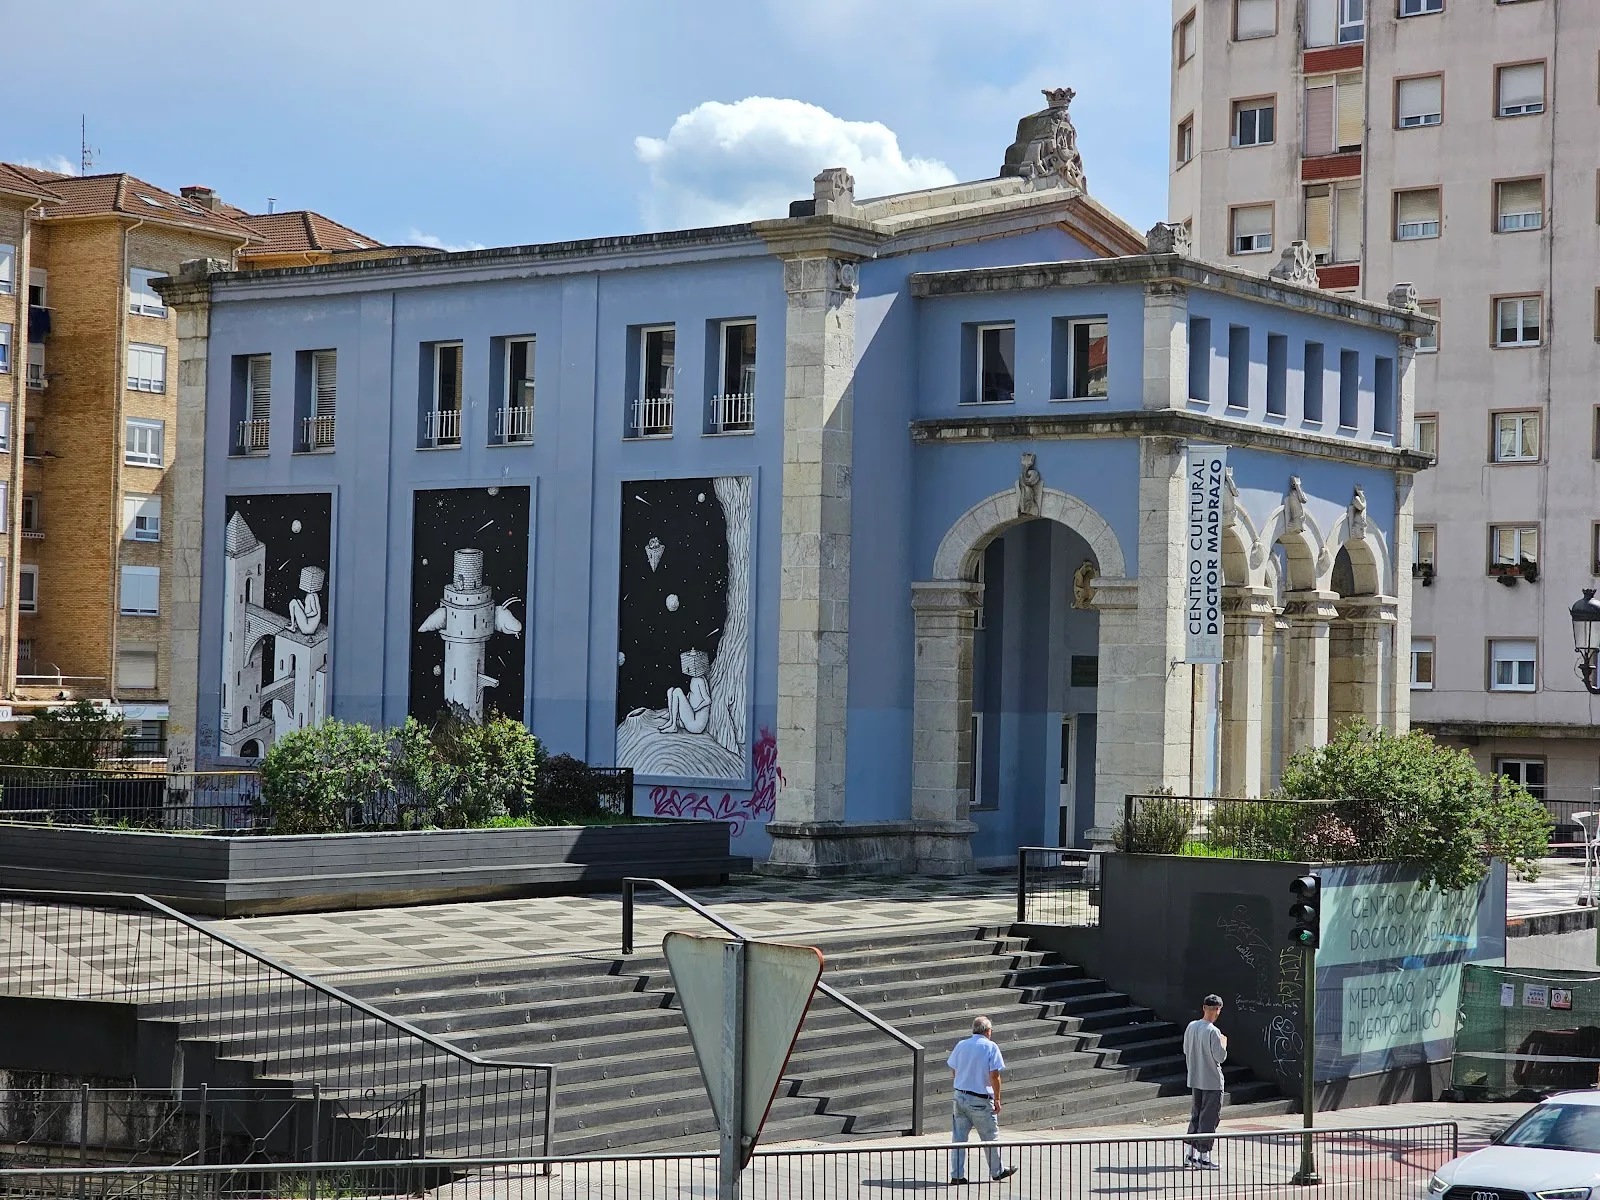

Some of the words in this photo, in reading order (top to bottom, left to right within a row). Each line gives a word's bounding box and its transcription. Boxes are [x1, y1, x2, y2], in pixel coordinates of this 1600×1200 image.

[1190, 458, 1205, 551] CULTURAL
[1207, 459, 1222, 553] MADRAZO
[1189, 559, 1202, 635] CENTRO
[1206, 559, 1218, 635] DOCTOR
[1351, 893, 1405, 919] CENTRO
[1350, 924, 1406, 951] DOCTOR
[1349, 981, 1415, 1012] MERCADO
[1425, 977, 1441, 1000] DE
[1348, 1008, 1441, 1043] PUERTOCHICO
